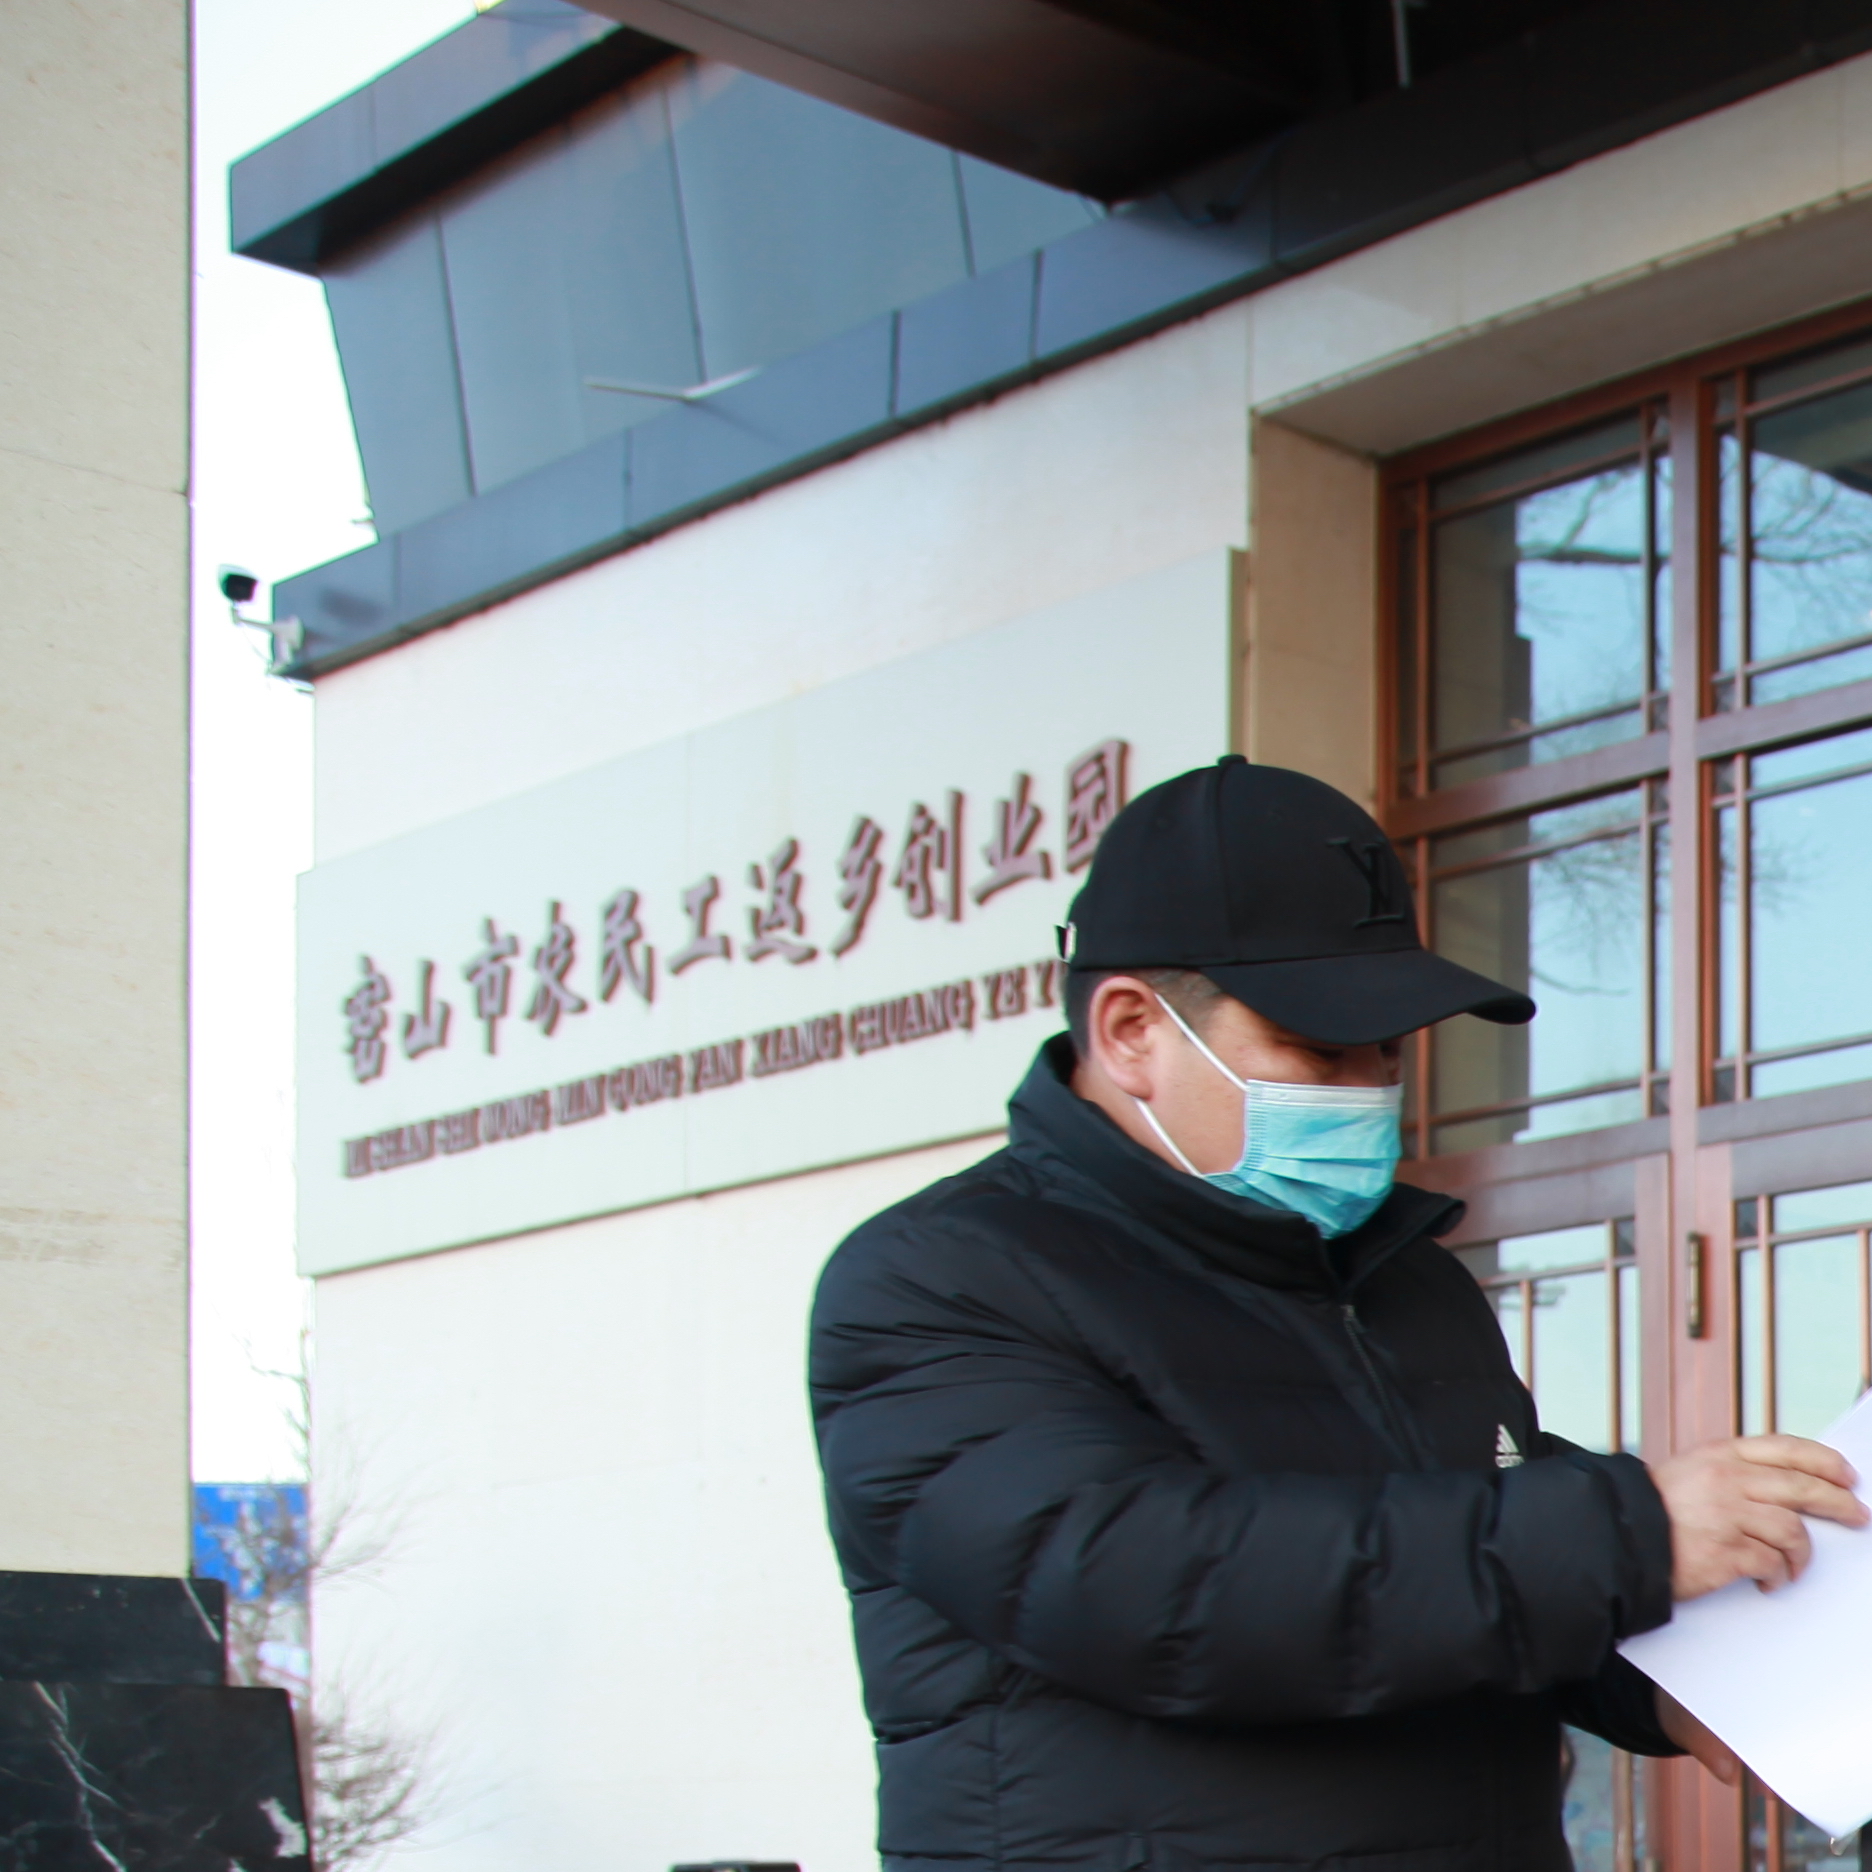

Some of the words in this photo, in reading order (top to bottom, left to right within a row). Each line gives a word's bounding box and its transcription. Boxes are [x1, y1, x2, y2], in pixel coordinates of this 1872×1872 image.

[342, 738, 1132, 1084] 密山市农民工返乡创业园
[752, 1012, 843, 1078] XIANG
[849, 979, 976, 1056] CHUANG
